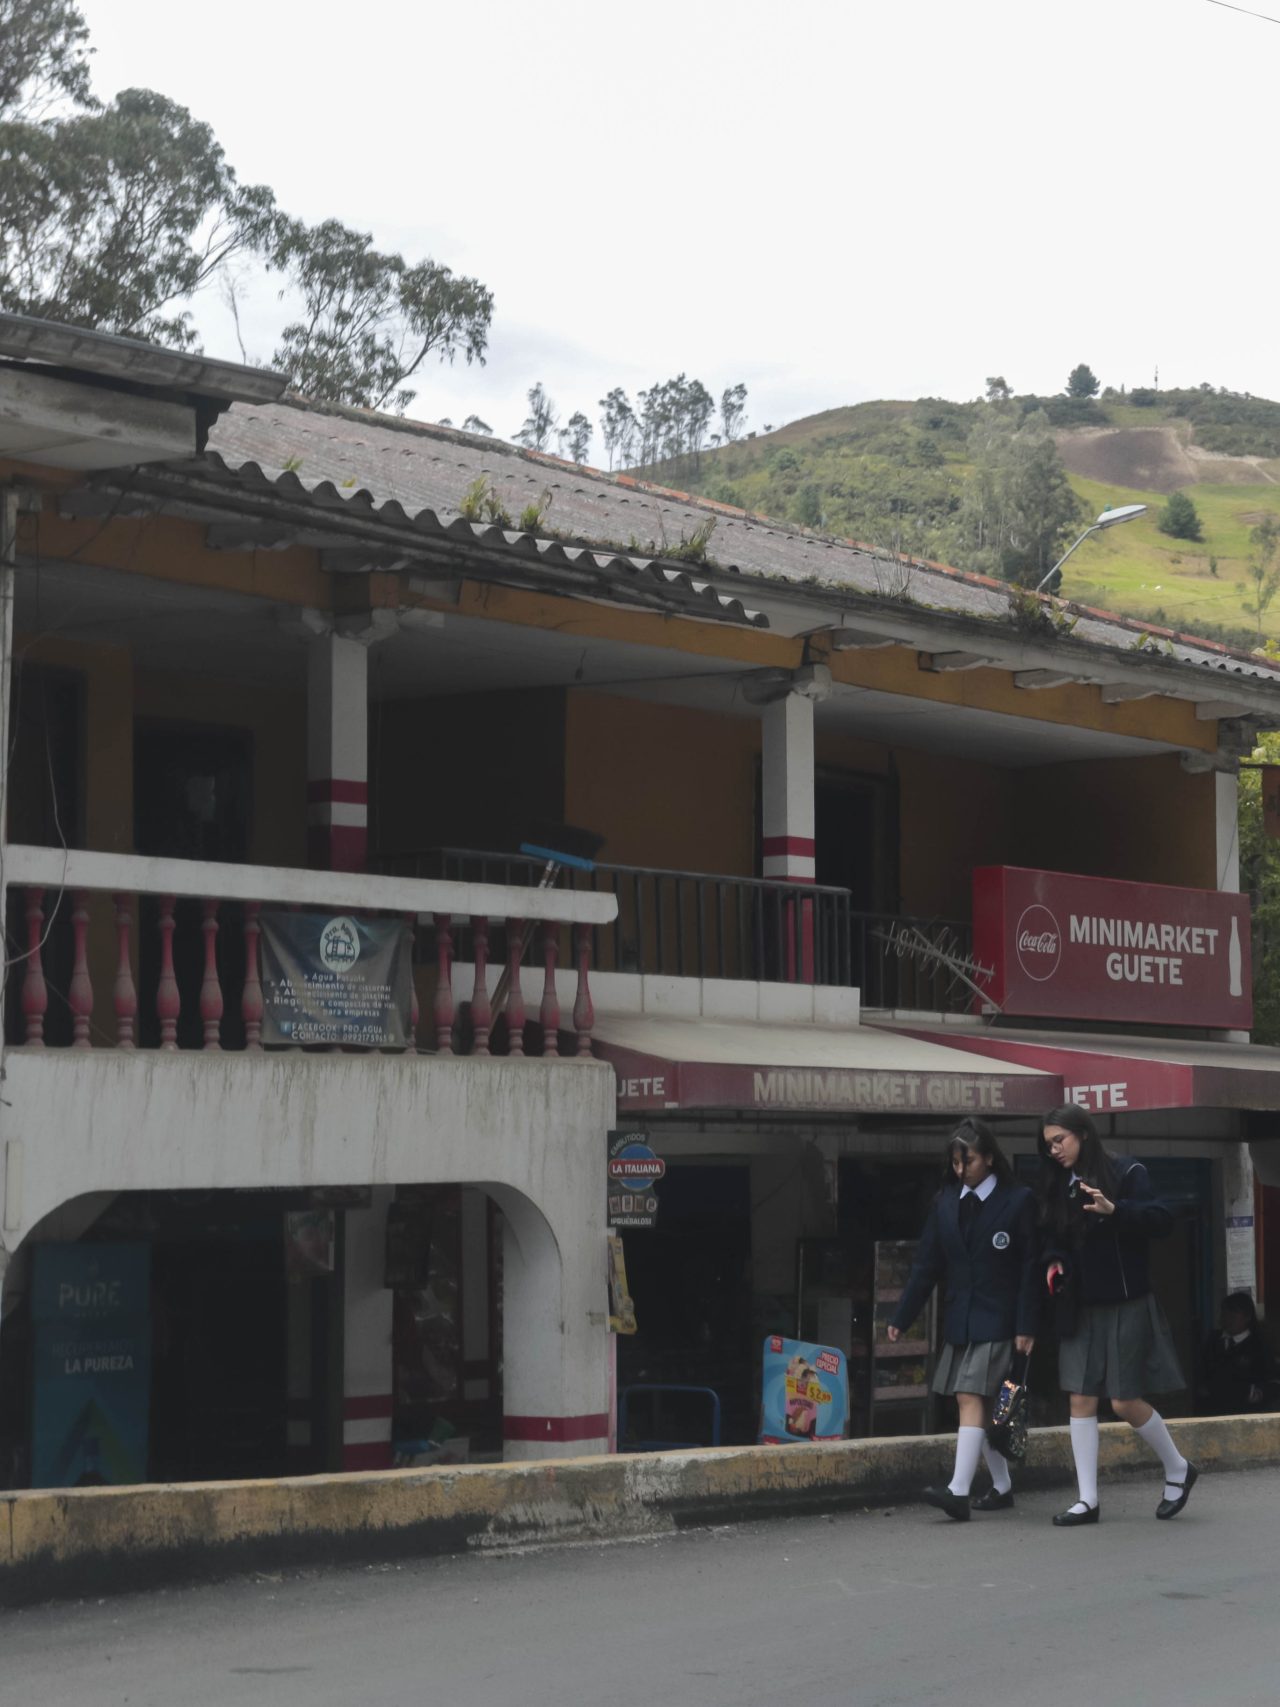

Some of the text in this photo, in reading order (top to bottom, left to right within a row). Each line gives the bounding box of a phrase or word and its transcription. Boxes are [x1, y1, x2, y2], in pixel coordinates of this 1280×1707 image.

[1069, 914, 1219, 955] MINIMARKET
[1106, 952, 1183, 985] GUETE
[753, 1072, 1005, 1108] MINIMARKET GUETE
[612, 1164, 661, 1174] LA ITALIANA
[59, 1281, 122, 1310] PURE
[65, 1355, 134, 1374] LA PUREZA
